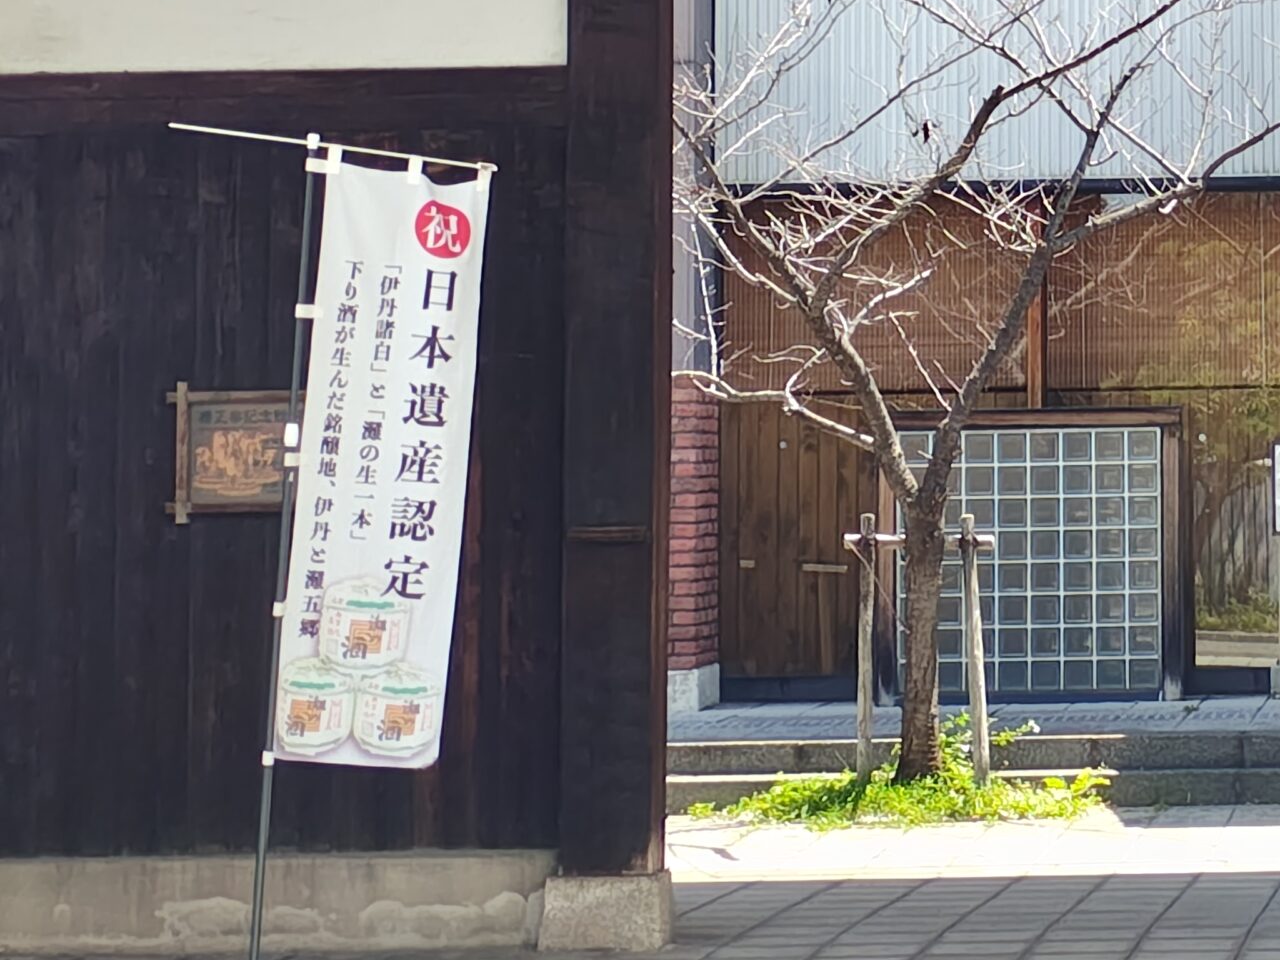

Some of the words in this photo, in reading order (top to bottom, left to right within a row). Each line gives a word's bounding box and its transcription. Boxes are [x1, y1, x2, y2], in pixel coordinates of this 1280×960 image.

[420, 205, 462, 254] 祝
[380, 269, 458, 600] 日本遺産認定
